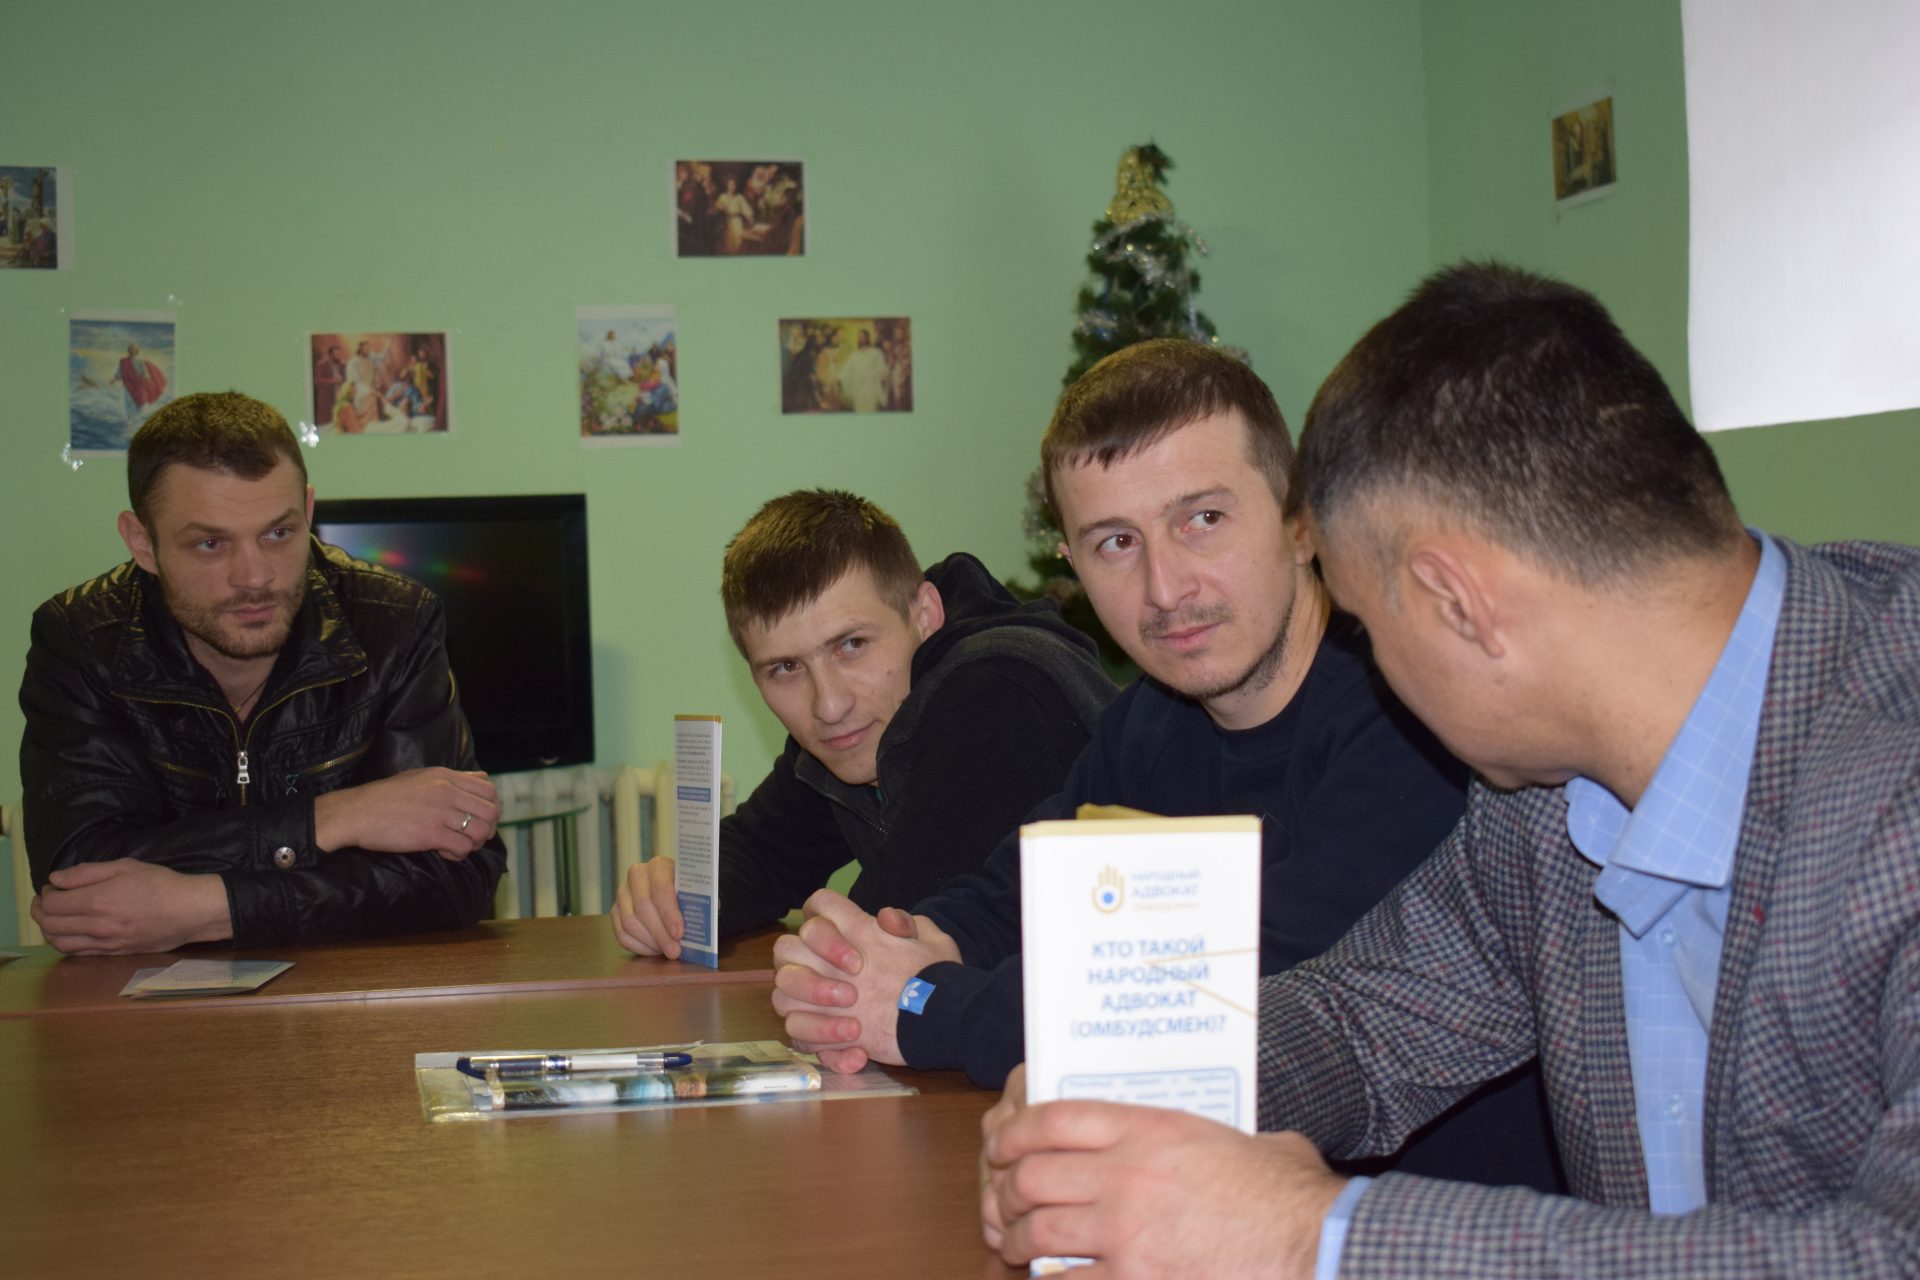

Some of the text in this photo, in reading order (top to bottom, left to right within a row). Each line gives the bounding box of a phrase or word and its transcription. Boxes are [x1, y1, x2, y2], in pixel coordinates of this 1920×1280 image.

[1132, 884, 1199, 898] АДВОКАТ
[1091, 934, 1206, 957] КТО ТАКОЙ
[1088, 960, 1210, 984] НАРОДНЫЙ
[1101, 990, 1197, 1011] АДВОКАТ
